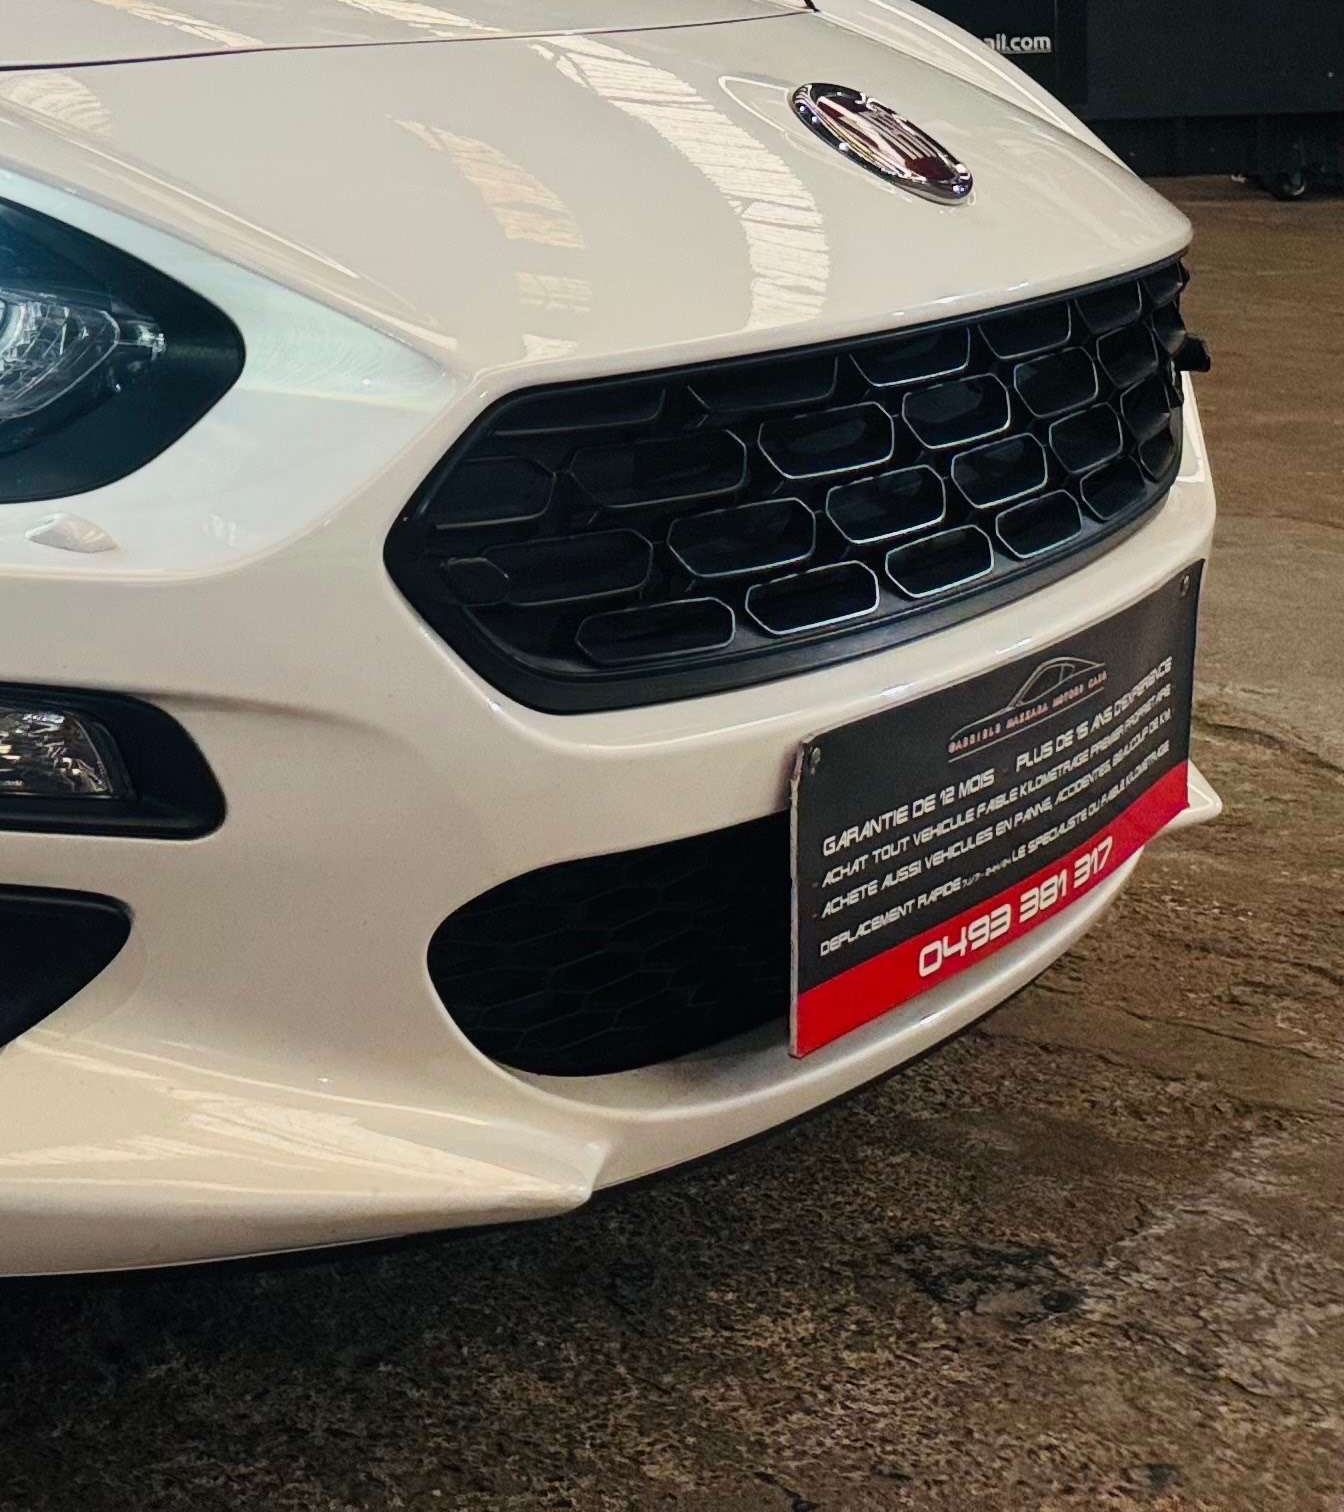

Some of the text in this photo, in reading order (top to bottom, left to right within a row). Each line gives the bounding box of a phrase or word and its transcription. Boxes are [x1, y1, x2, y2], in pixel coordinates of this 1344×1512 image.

[821, 853, 869, 888] ACHAT
[872, 835, 911, 864] TOUT
[913, 806, 975, 847] VEHICULE
[976, 787, 1019, 820] FAIBLE
[1019, 748, 1090, 799] KILOMETRAGE
[822, 804, 910, 857] GARANTIE
[912, 793, 937, 819] DE
[940, 785, 956, 807] 12
[958, 767, 995, 800] MOIS
[1015, 740, 1054, 773] PLUS
[1056, 728, 1075, 753] DE
[1090, 705, 1113, 734] ANS
[820, 898, 916, 957] DEPLACEMENT
[917, 876, 962, 910] RAPIDE
[821, 879, 879, 919] ACHETE
[881, 860, 922, 891] AUSSI
[925, 826, 994, 870] VEHICULES
[995, 816, 1012, 837] EN
[918, 902, 1012, 978] 0493
[1018, 868, 1068, 924] 381
[1073, 834, 1113, 889] 317
